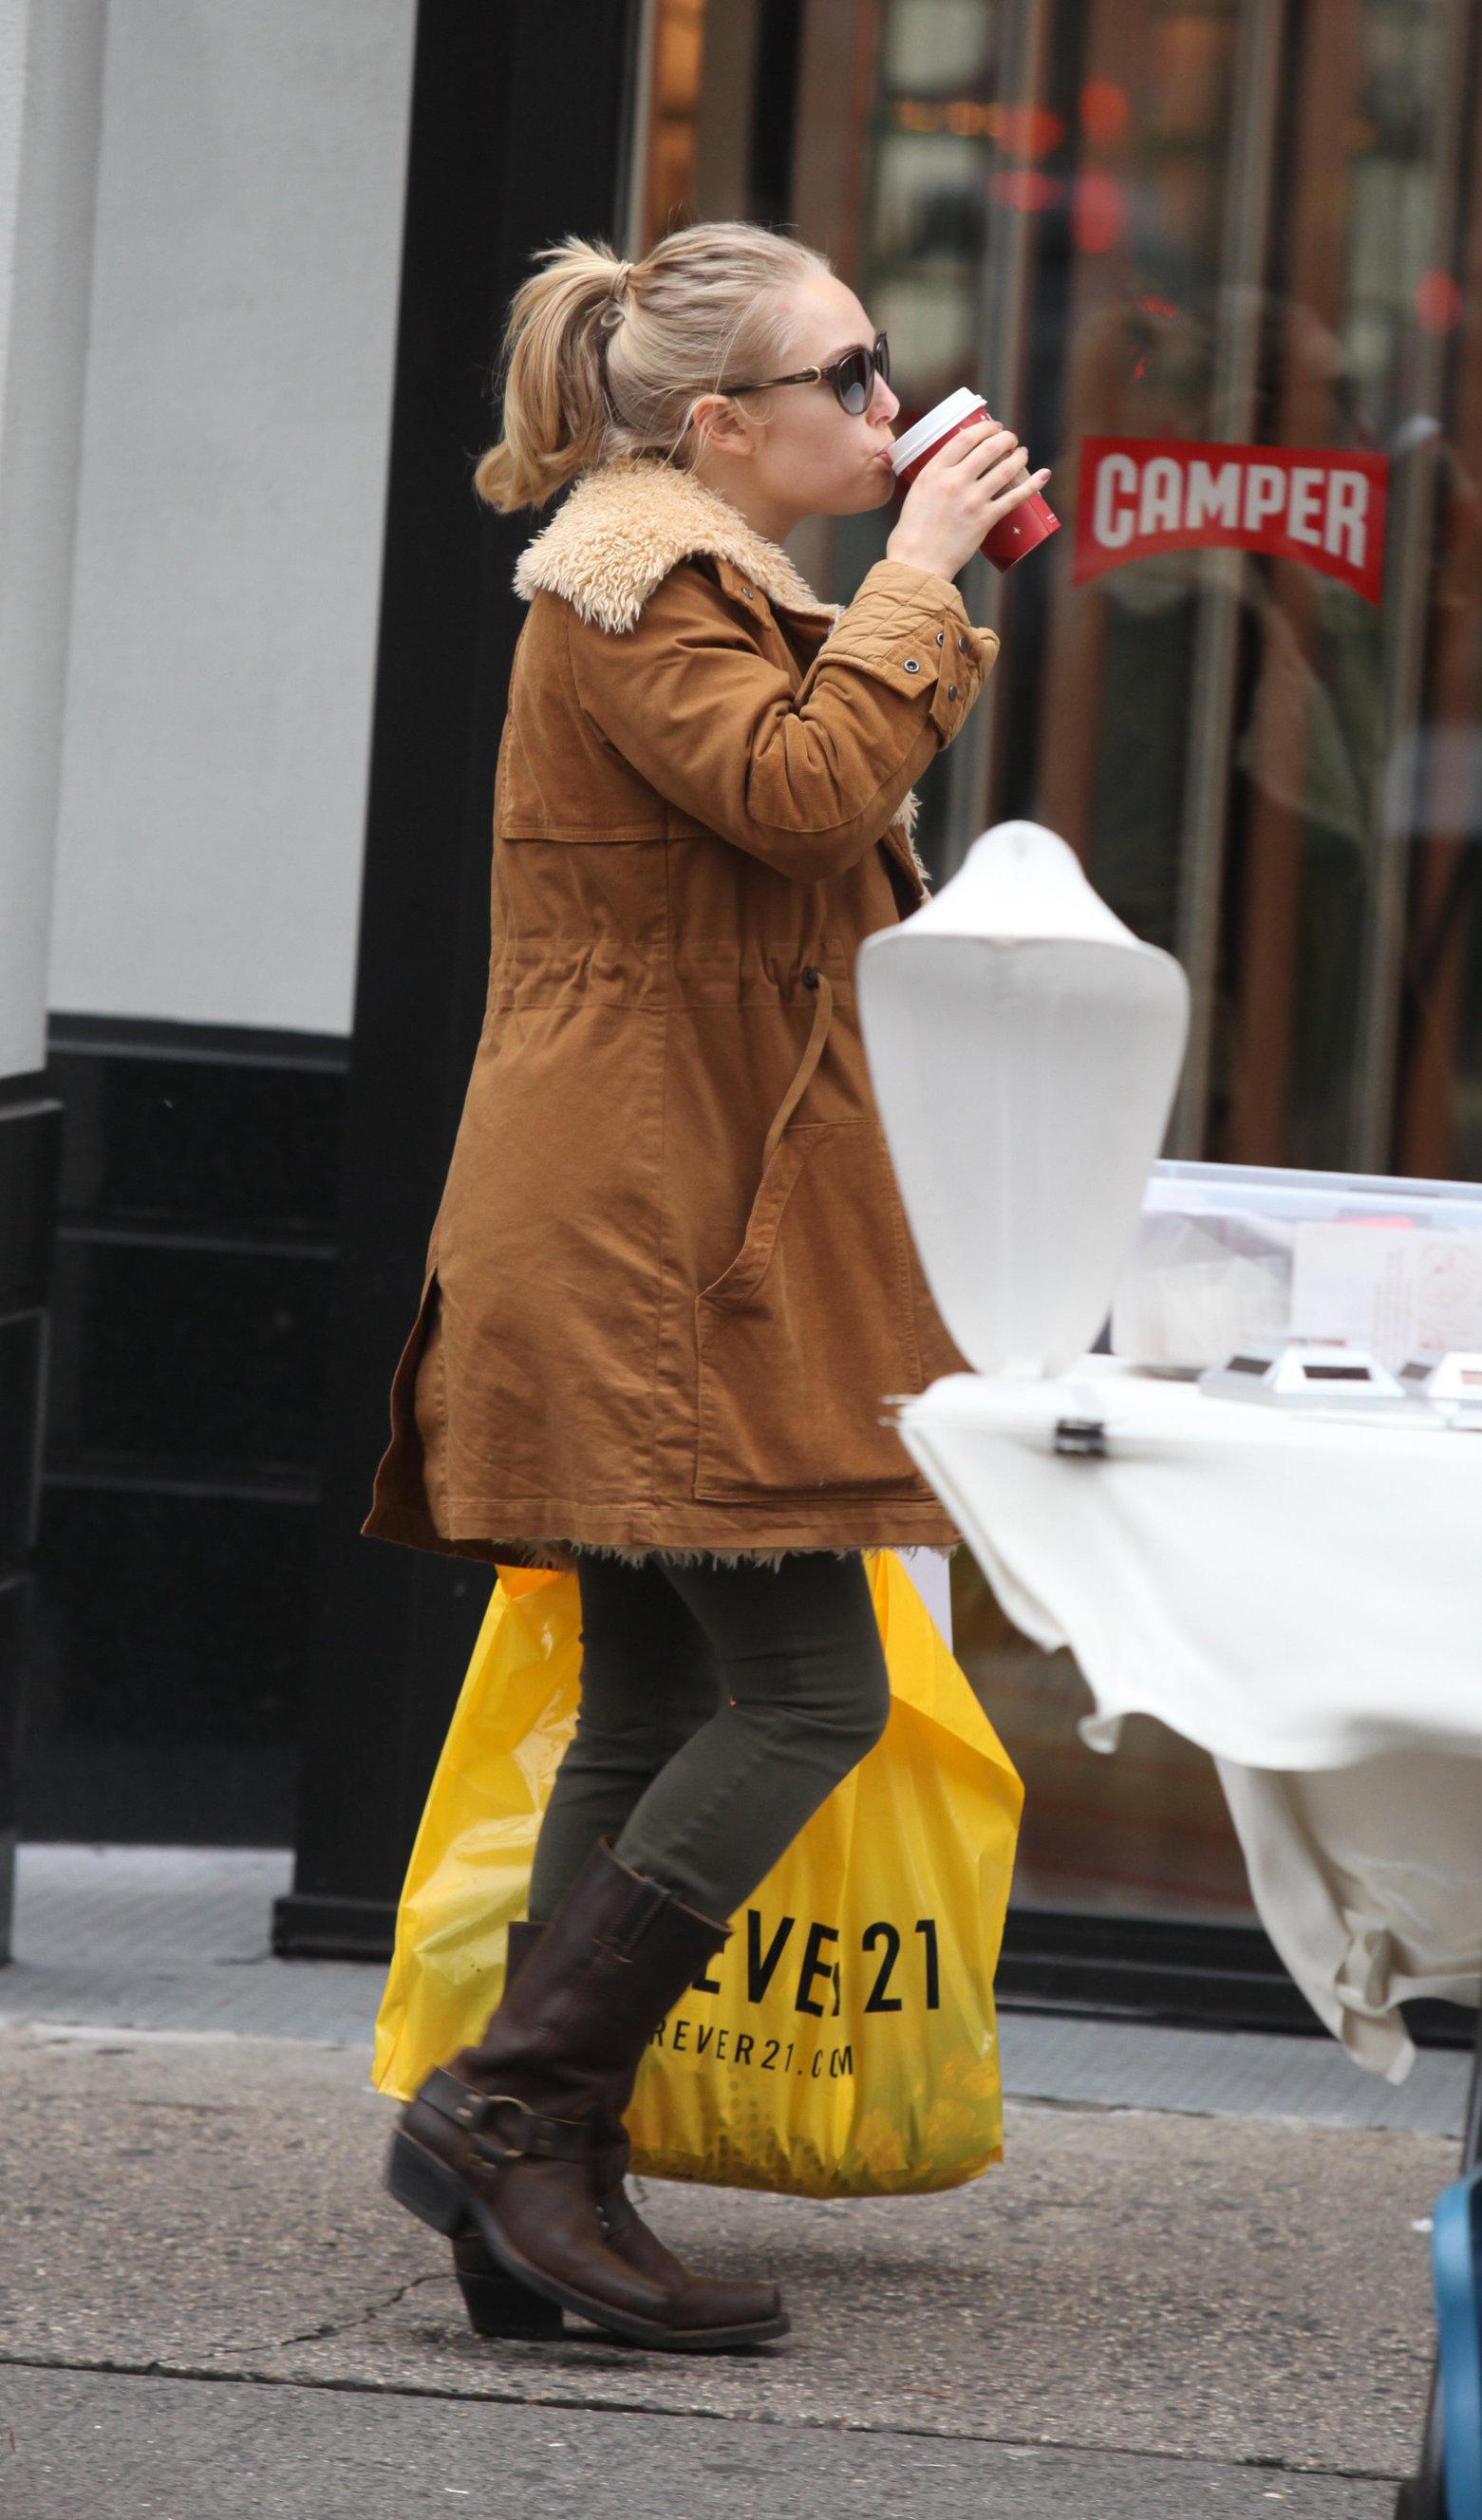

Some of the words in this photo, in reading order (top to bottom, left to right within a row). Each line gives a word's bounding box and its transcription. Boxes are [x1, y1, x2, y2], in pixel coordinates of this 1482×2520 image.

[1094, 453, 1369, 568] CAMPER
[691, 1909, 839, 2018] VE
[861, 1919, 940, 2013] 21
